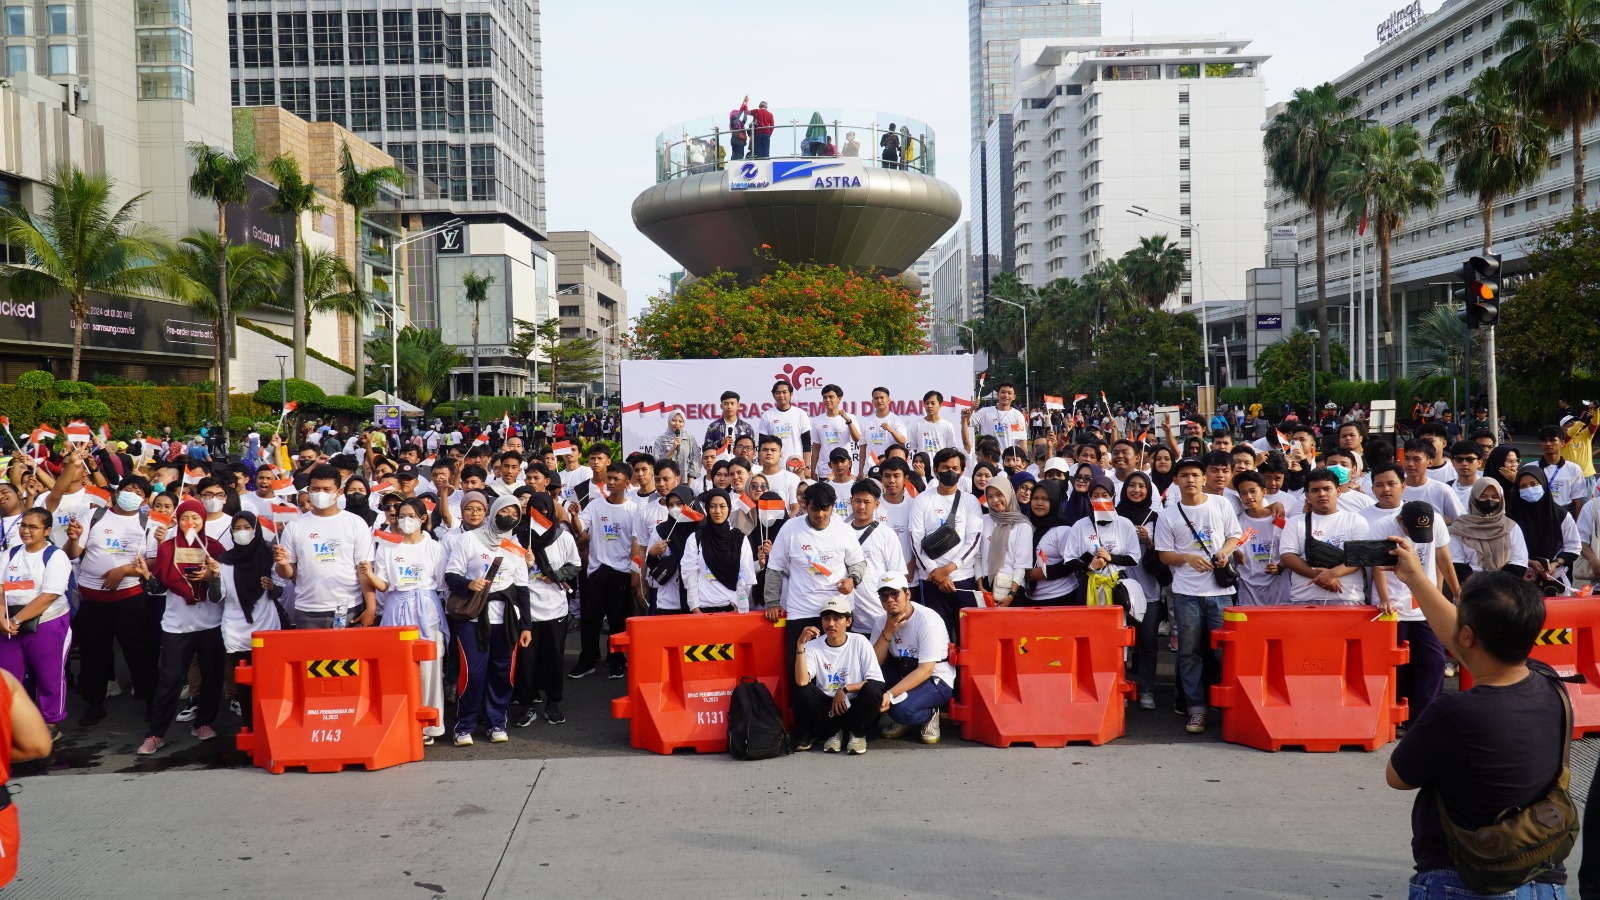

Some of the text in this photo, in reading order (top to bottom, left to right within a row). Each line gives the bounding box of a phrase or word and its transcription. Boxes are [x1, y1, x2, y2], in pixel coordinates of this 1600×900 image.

[1376, 0, 1420, 40] pullman
[814, 176, 862, 188] ASTRA
[252, 225, 280, 248] Galaxy AI
[0, 298, 35, 319] cked
[90, 306, 103, 316] 2024
[103, 308, 110, 317] at
[82, 322, 90, 330] on
[92, 323, 135, 335] samsung.com/id
[166, 325, 190, 336] Pre-order
[190, 329, 204, 338] starts
[804, 377, 823, 387] PIC
[672, 400, 925, 419] EKLRAS EMU DMAI
[697, 710, 724, 725] K131
[311, 729, 342, 742] K143
